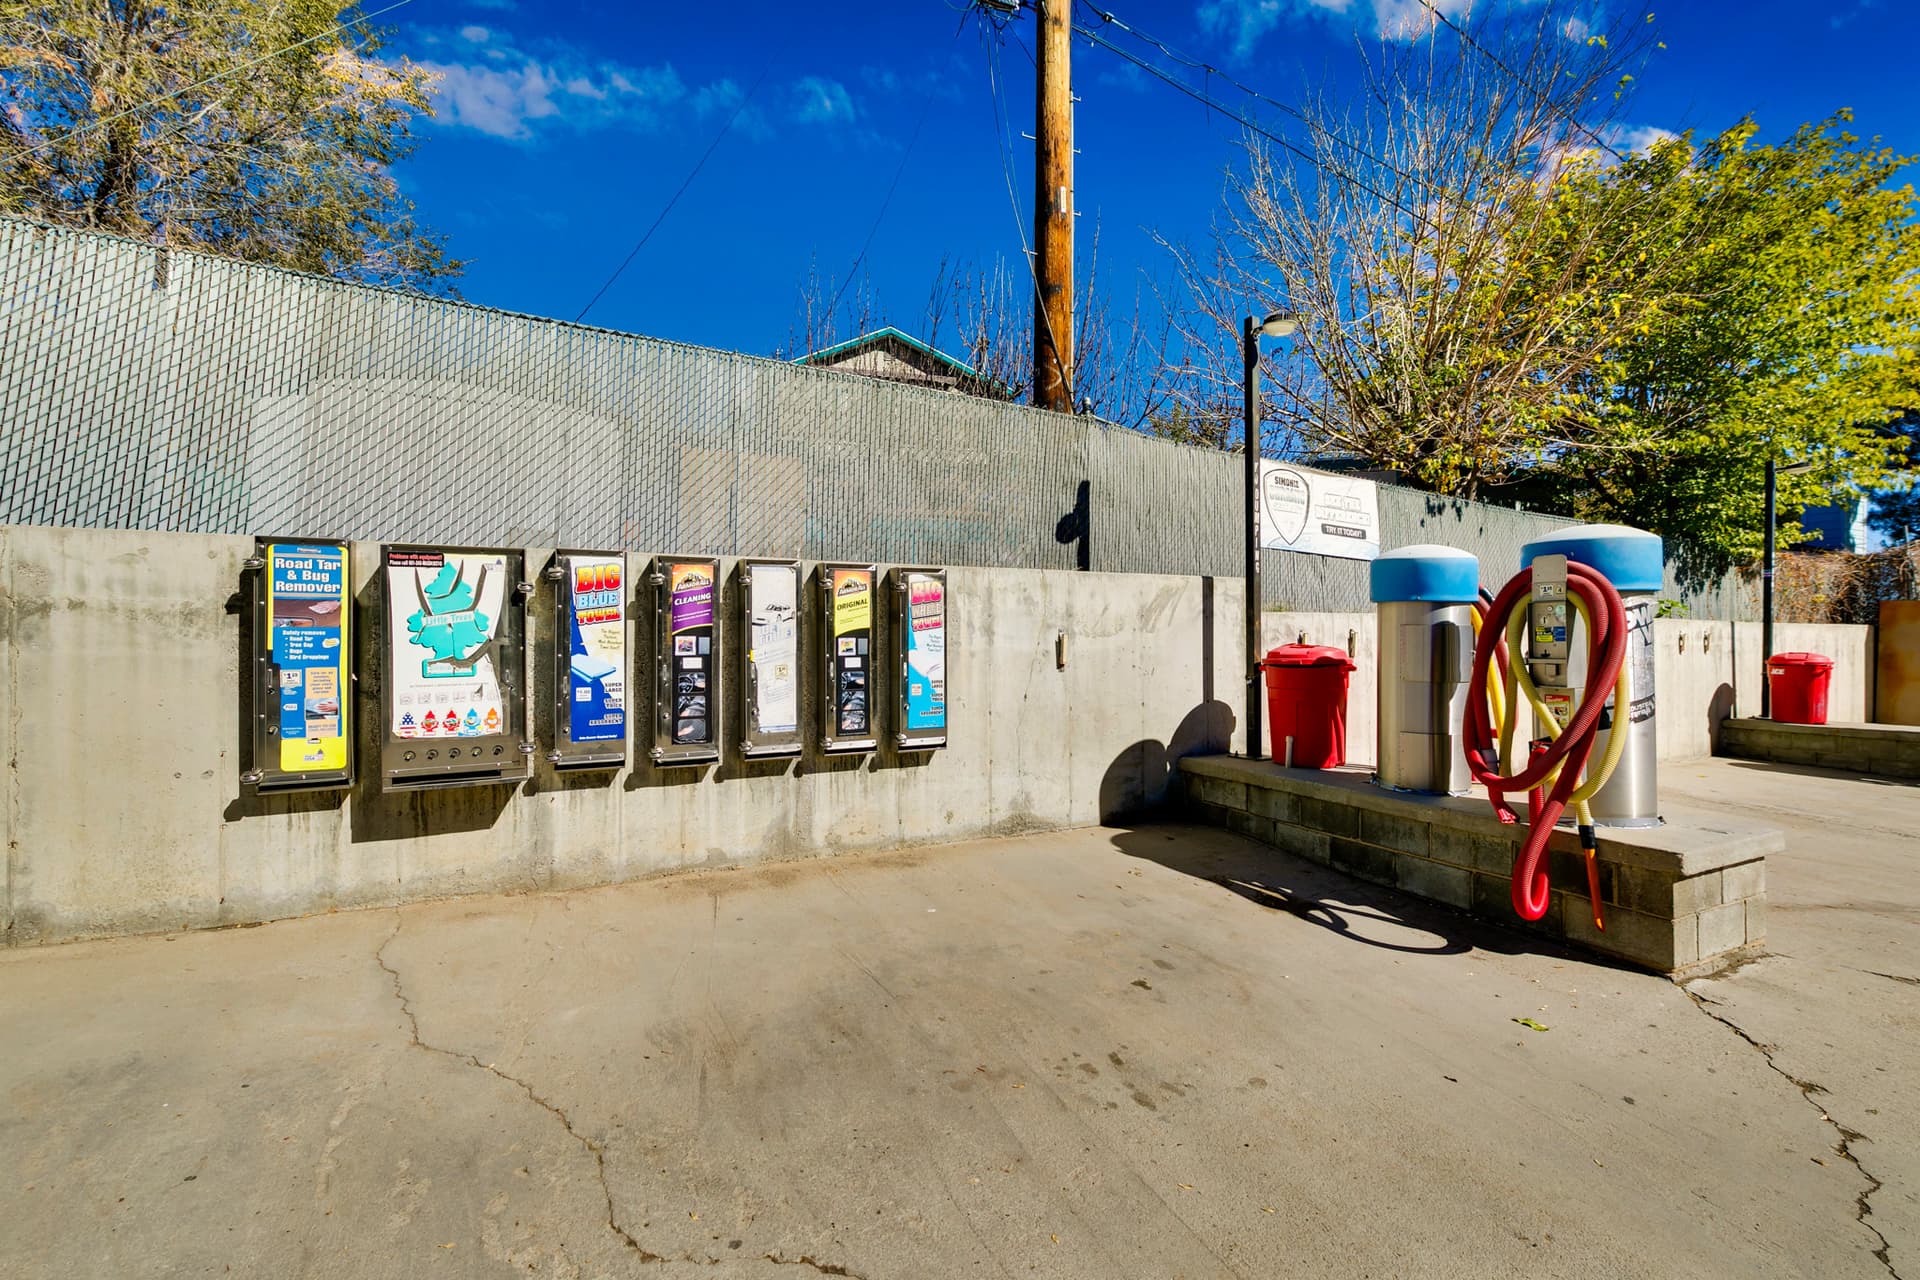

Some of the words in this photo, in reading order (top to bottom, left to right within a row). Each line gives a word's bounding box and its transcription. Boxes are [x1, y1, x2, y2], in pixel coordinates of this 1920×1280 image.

[274, 558, 313, 569] Road
[317, 559, 341, 570] Tar
[287, 570, 297, 580] &
[302, 570, 330, 583] Bug
[575, 563, 622, 593] BIG
[275, 581, 341, 593] Remover
[576, 592, 620, 610] BLUE
[674, 592, 712, 606] CLEANING
[836, 598, 868, 611] ORIGINAL
[577, 607, 622, 625] TOWEL
